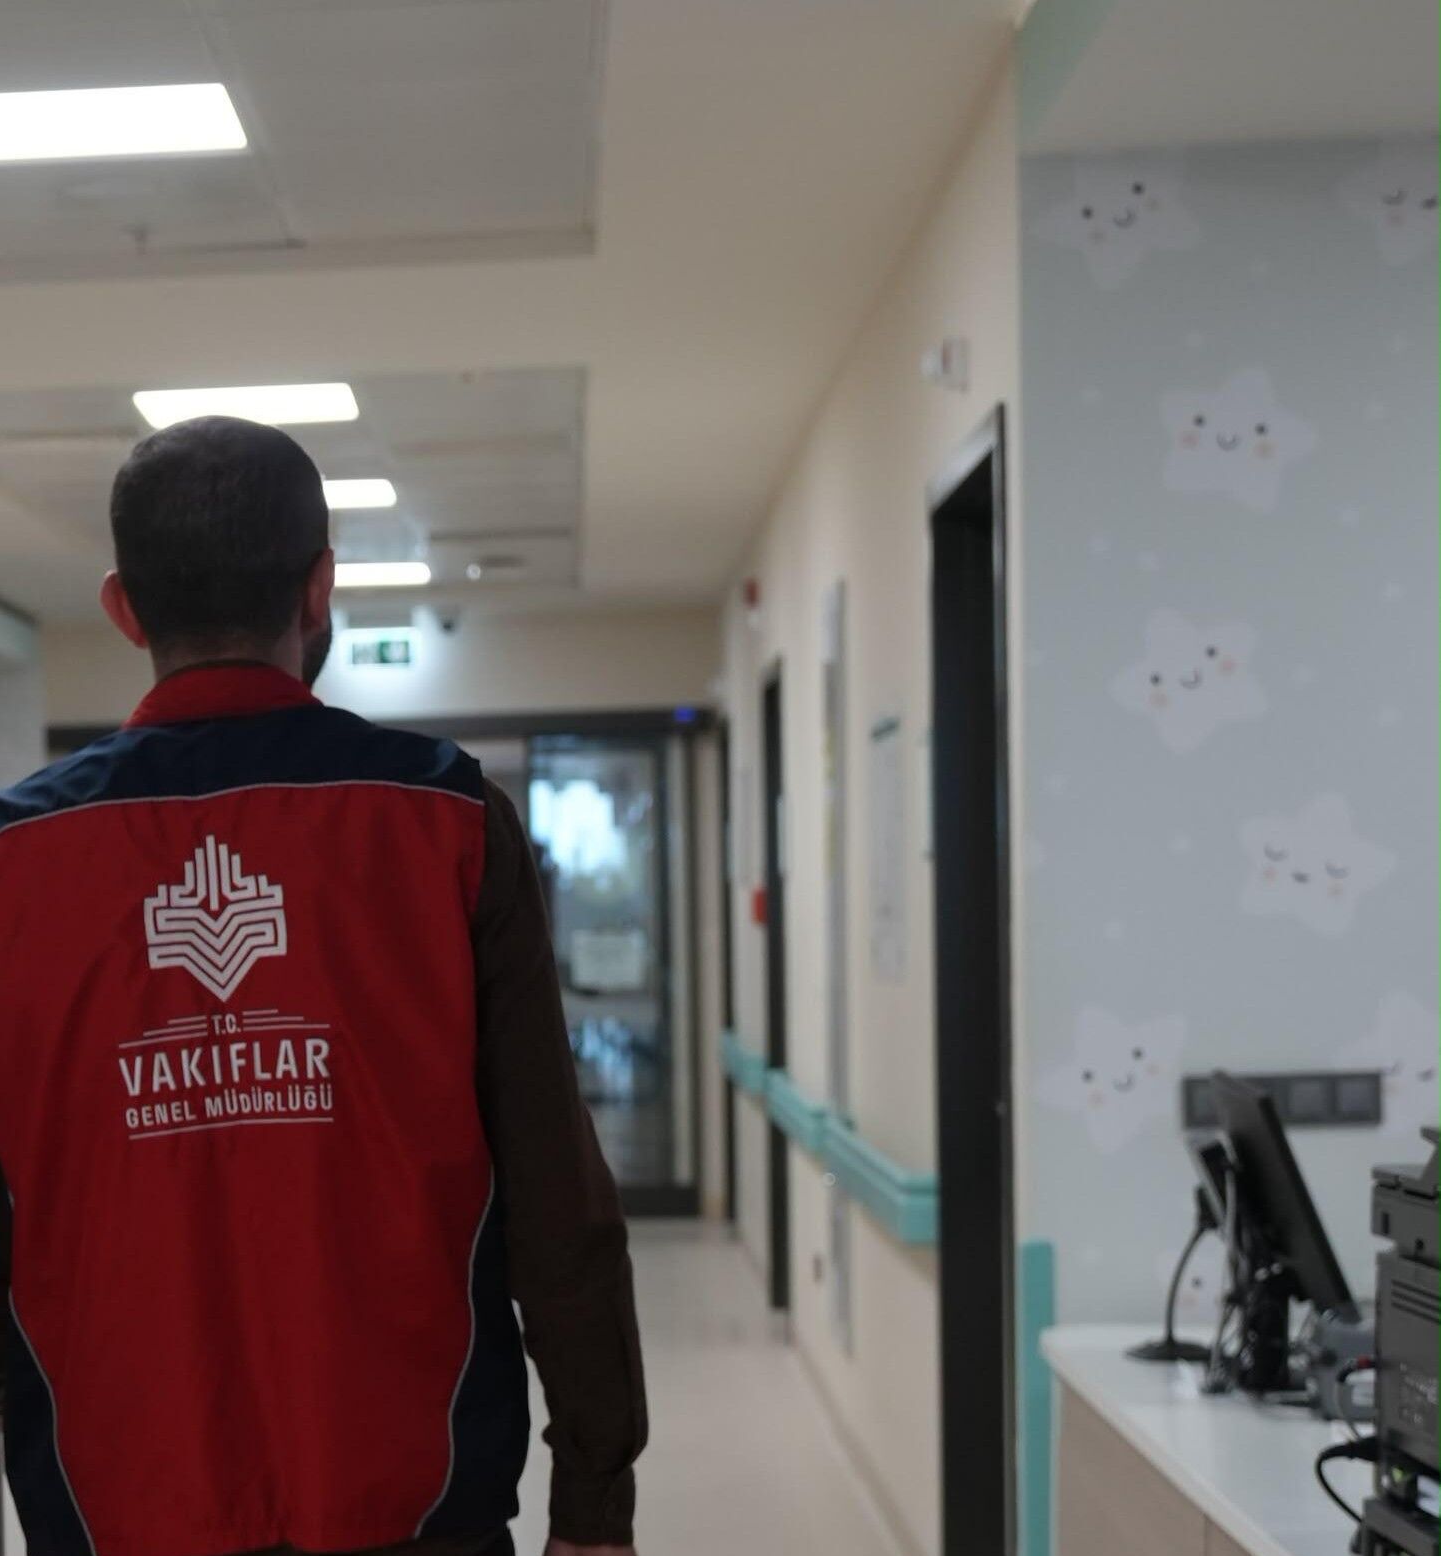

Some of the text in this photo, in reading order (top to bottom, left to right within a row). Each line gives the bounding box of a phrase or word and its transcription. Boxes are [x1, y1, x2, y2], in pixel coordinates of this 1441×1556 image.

[212, 1013, 241, 1035] T.C.
[118, 1038, 331, 1097] VAKIFLAR
[125, 1084, 334, 1129] GENEL MÜDÜRLÜĞÜ
